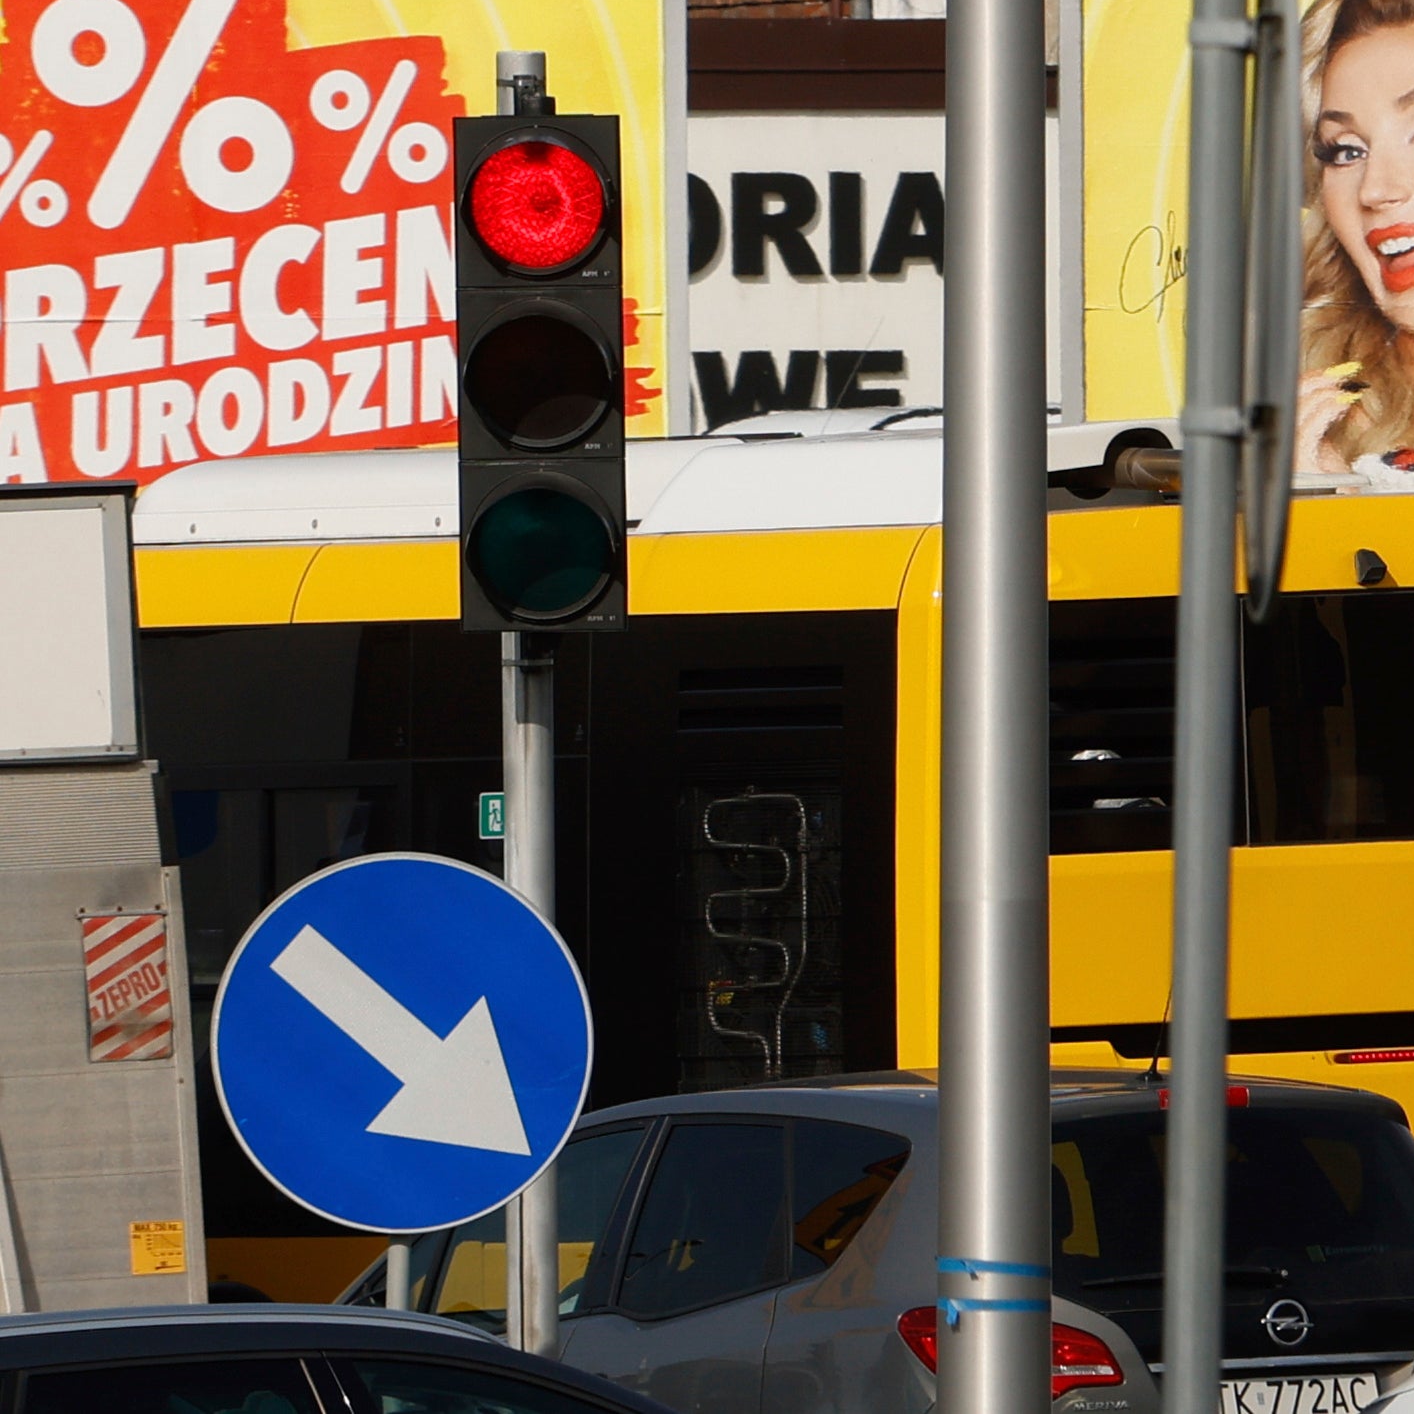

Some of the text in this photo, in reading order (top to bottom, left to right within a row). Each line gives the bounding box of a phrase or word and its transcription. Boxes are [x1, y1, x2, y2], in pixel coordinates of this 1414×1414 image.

[4, 202, 457, 392] RZECEN
[71, 334, 458, 478] URODZIN
[692, 350, 904, 434] WE
[96, 961, 161, 1021] ZEPRO
[1266, 1376, 1368, 1414] 772AC
